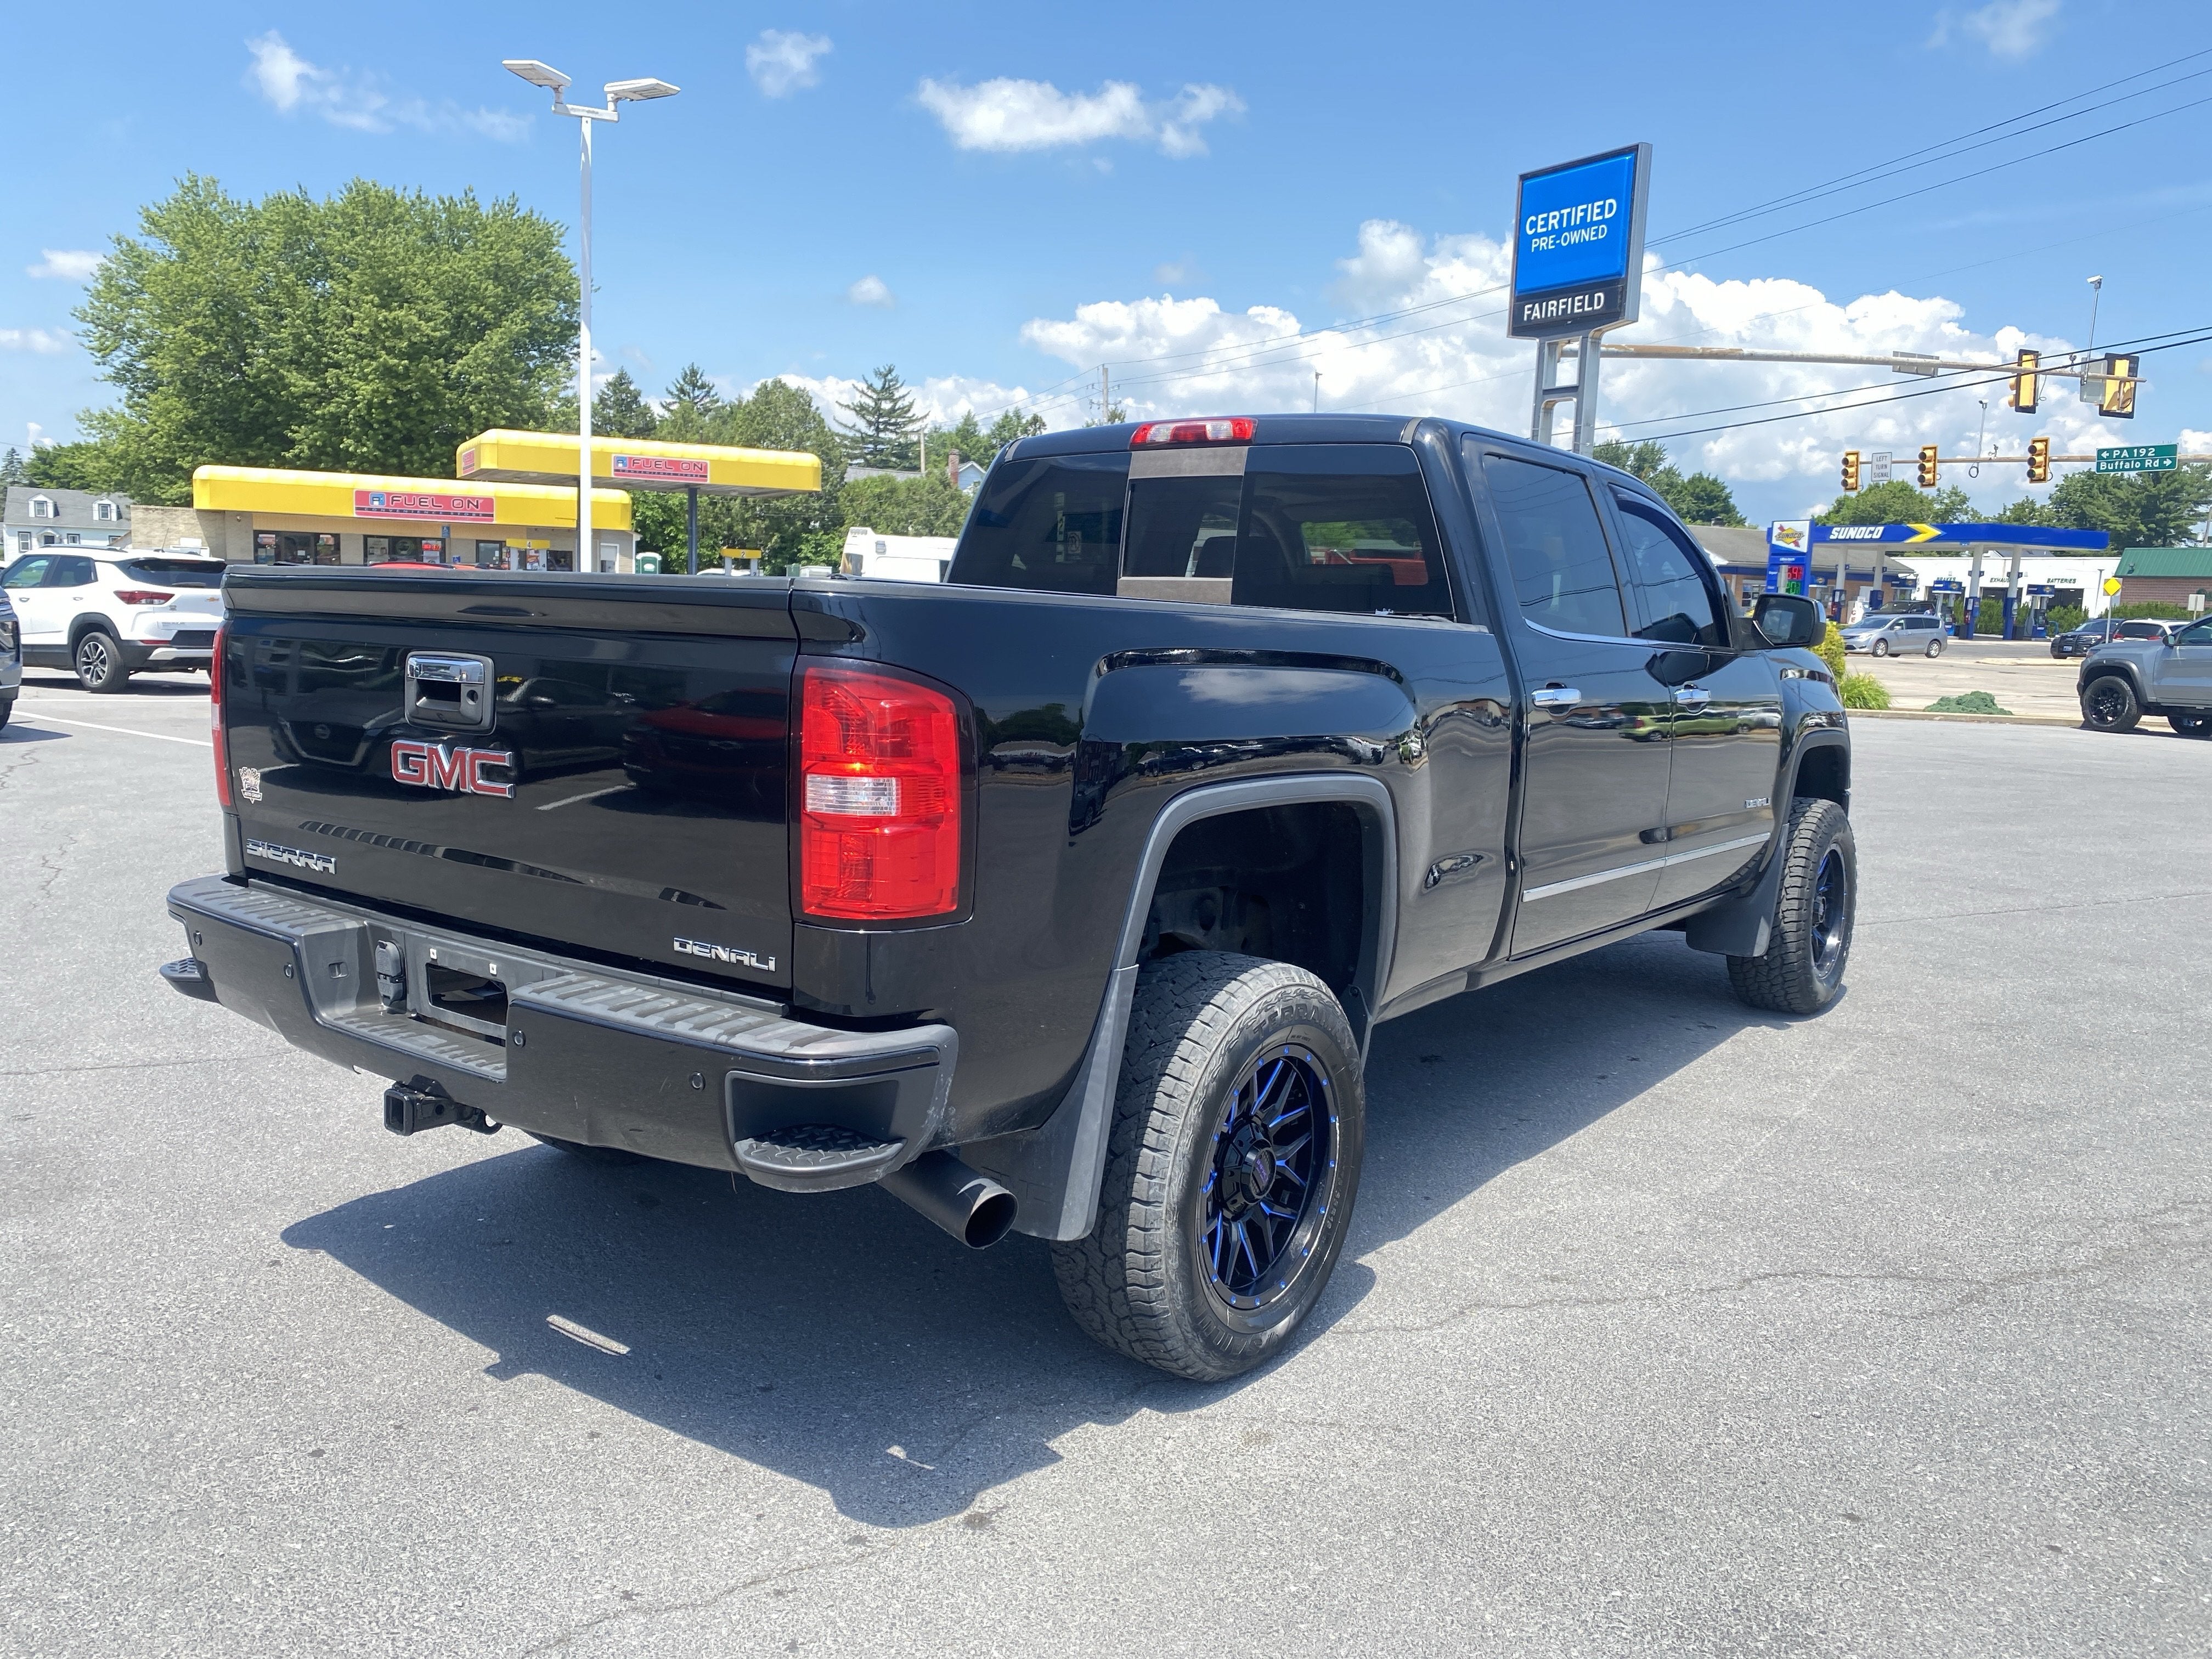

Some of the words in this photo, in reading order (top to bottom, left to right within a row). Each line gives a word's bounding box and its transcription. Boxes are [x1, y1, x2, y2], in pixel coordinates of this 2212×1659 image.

[1526, 199, 1617, 235] CERTIFIED
[1531, 224, 1607, 253] PRE-OWNED
[1523, 292, 1605, 321] FAIRFIELD
[2100, 460, 2141, 470] Buffalo
[2145, 458, 2160, 468] Rd
[2113, 449, 2129, 459] PA
[2133, 448, 2155, 457] 192
[632, 459, 674, 470] FUEL
[681, 462, 703, 472] ON
[364, 507, 443, 516] CONVENIENCE
[390, 495, 443, 509] FUEL
[452, 498, 480, 510] ON
[1829, 526, 1884, 540] SUNOCO
[391, 740, 516, 799] GMC
[246, 838, 336, 875] SIERRA
[673, 936, 776, 972] DENALI
